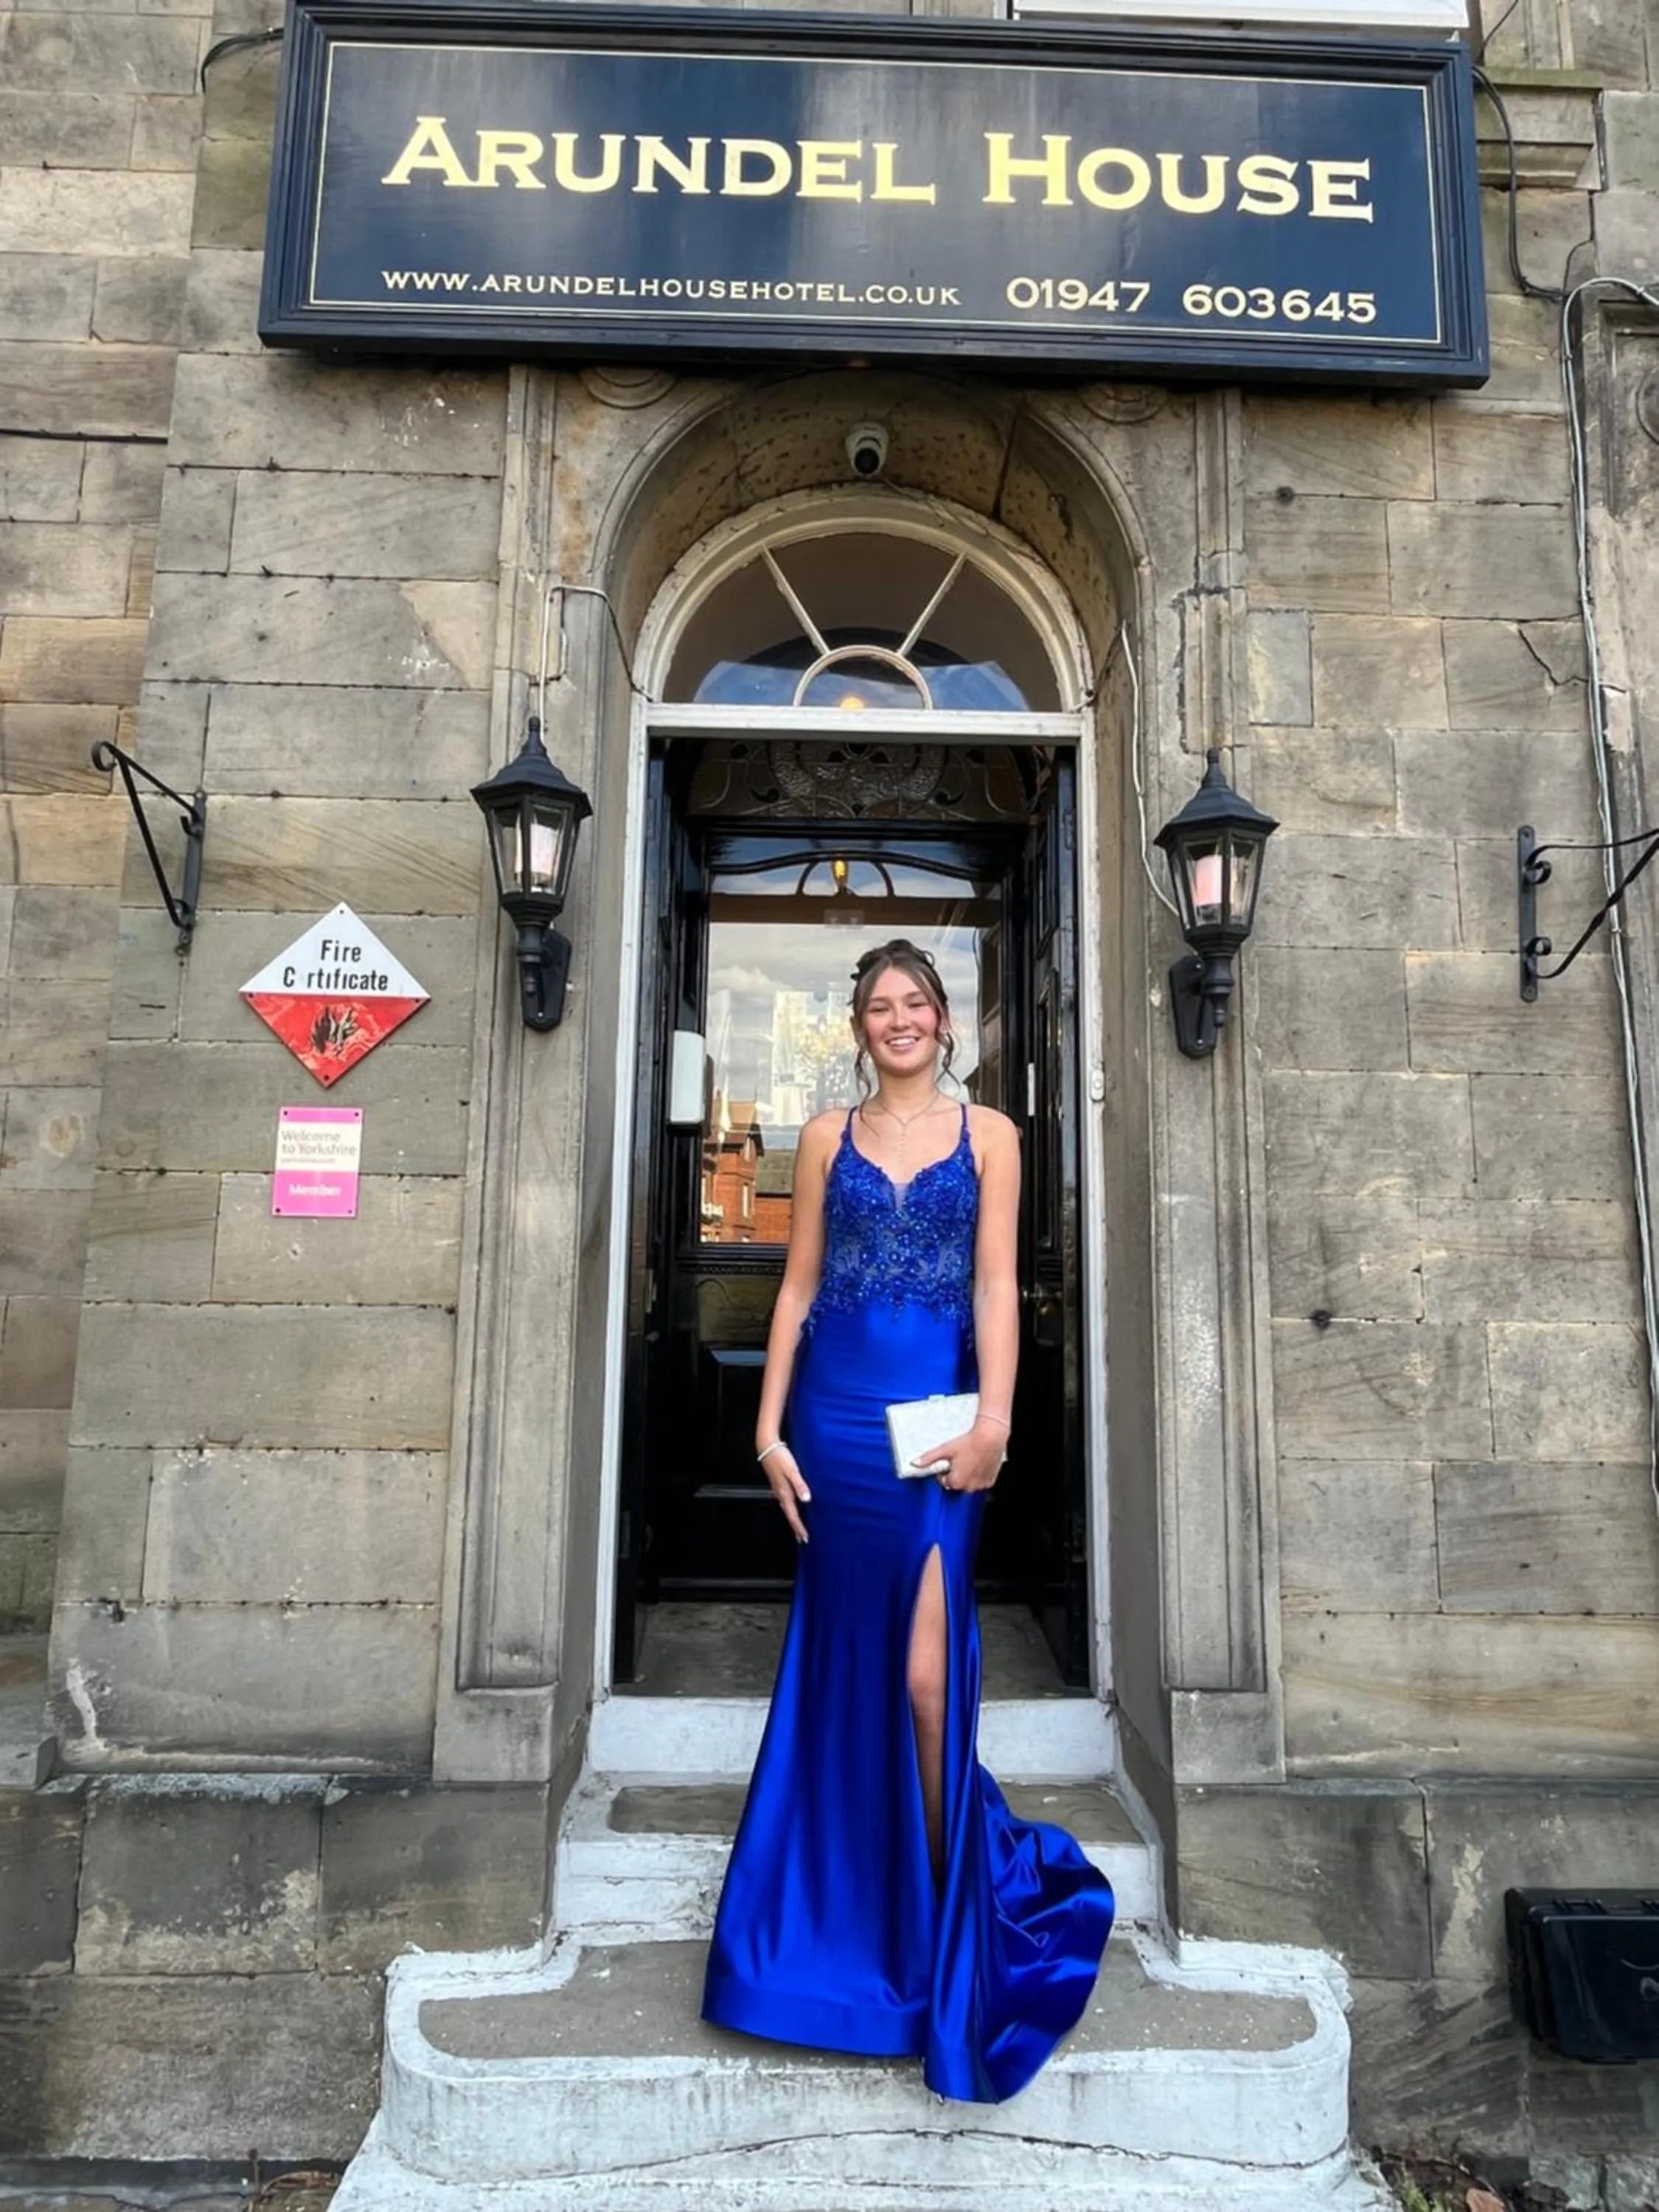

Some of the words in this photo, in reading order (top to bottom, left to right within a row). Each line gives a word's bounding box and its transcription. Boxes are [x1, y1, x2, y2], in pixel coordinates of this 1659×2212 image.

[381, 116, 936, 206] ARUNDEL
[982, 131, 1374, 223] HOUSE
[381, 271, 961, 306] WWW.ARUNDELHOUSEHOTEL.CO.UK
[1006, 276, 1150, 313] 01947
[1182, 284, 1377, 323] 603645
[321, 939, 361, 962] Fire
[283, 967, 389, 991] Crtificate
[281, 1130, 341, 1142] Welcome
[282, 1144, 295, 1154] to
[299, 1143, 358, 1155] Yorkshire
